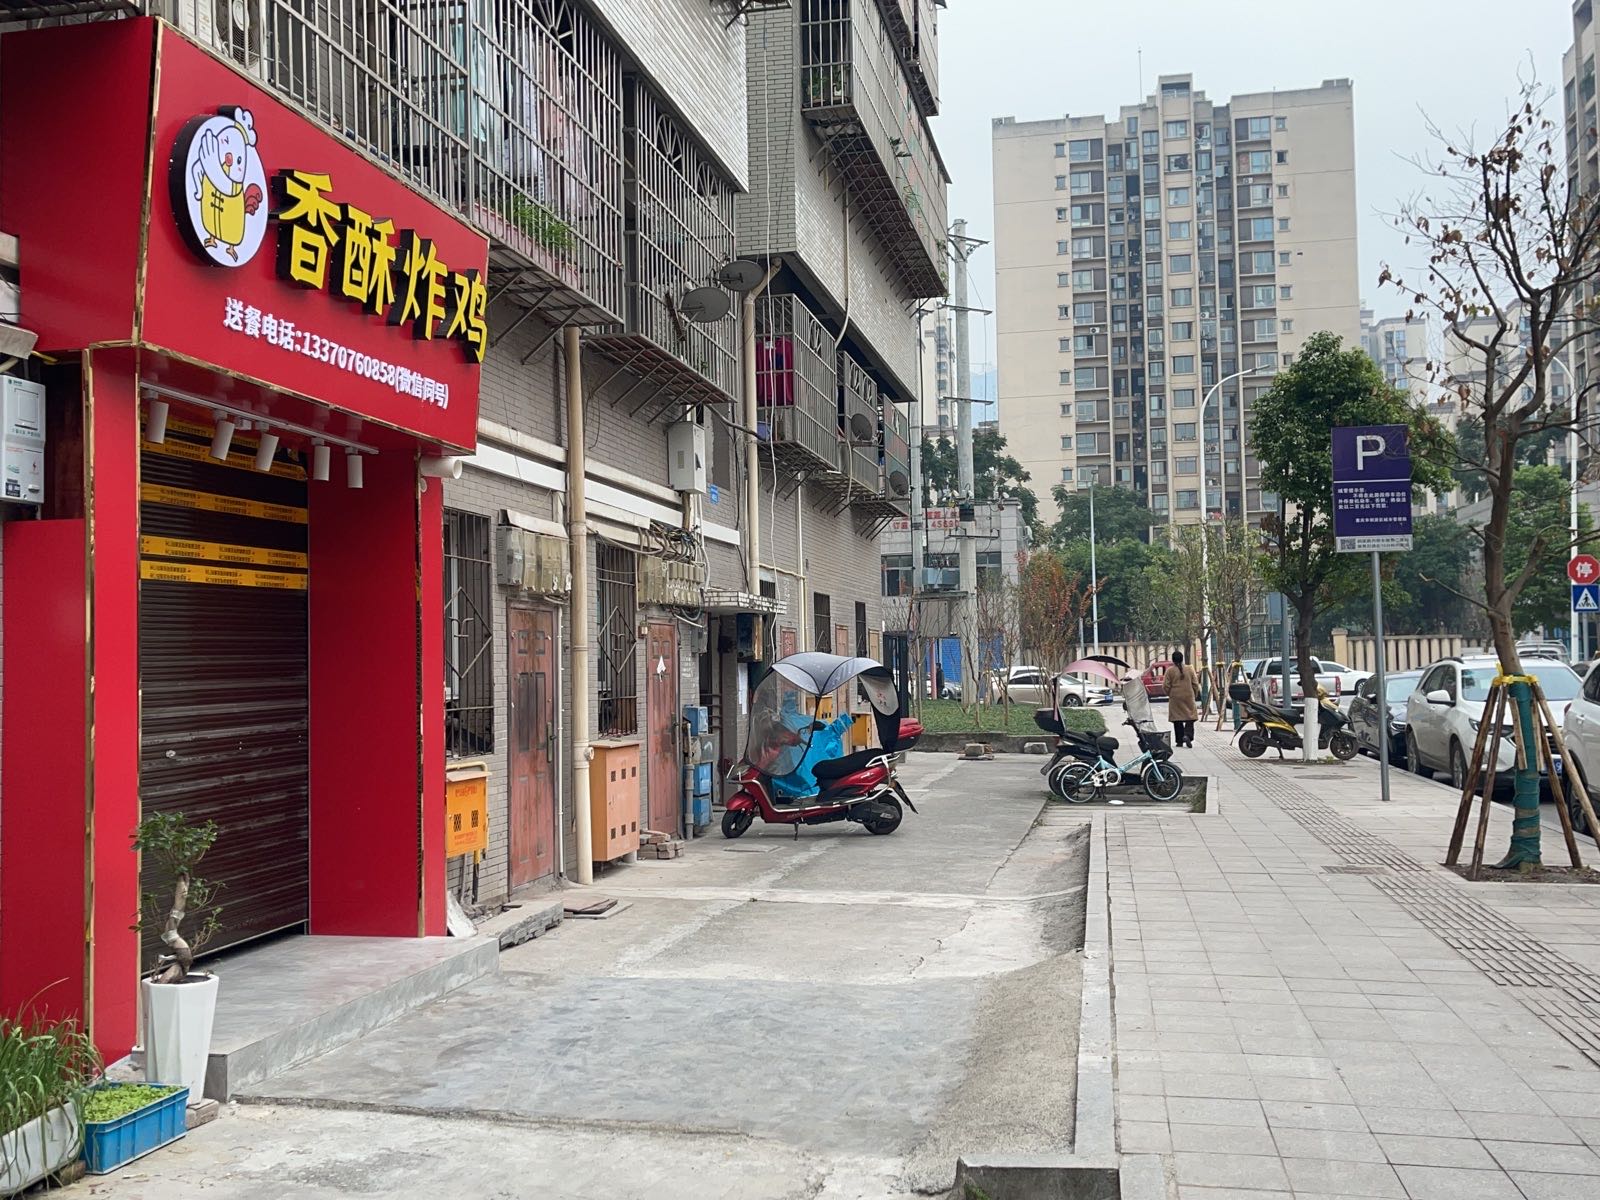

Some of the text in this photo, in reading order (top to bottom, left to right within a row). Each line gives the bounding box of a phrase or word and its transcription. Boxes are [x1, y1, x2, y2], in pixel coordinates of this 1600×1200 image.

[276, 169, 488, 364] 香酥炸鸡
[1356, 435, 1386, 471] P
[1575, 561, 1593, 578] 停
